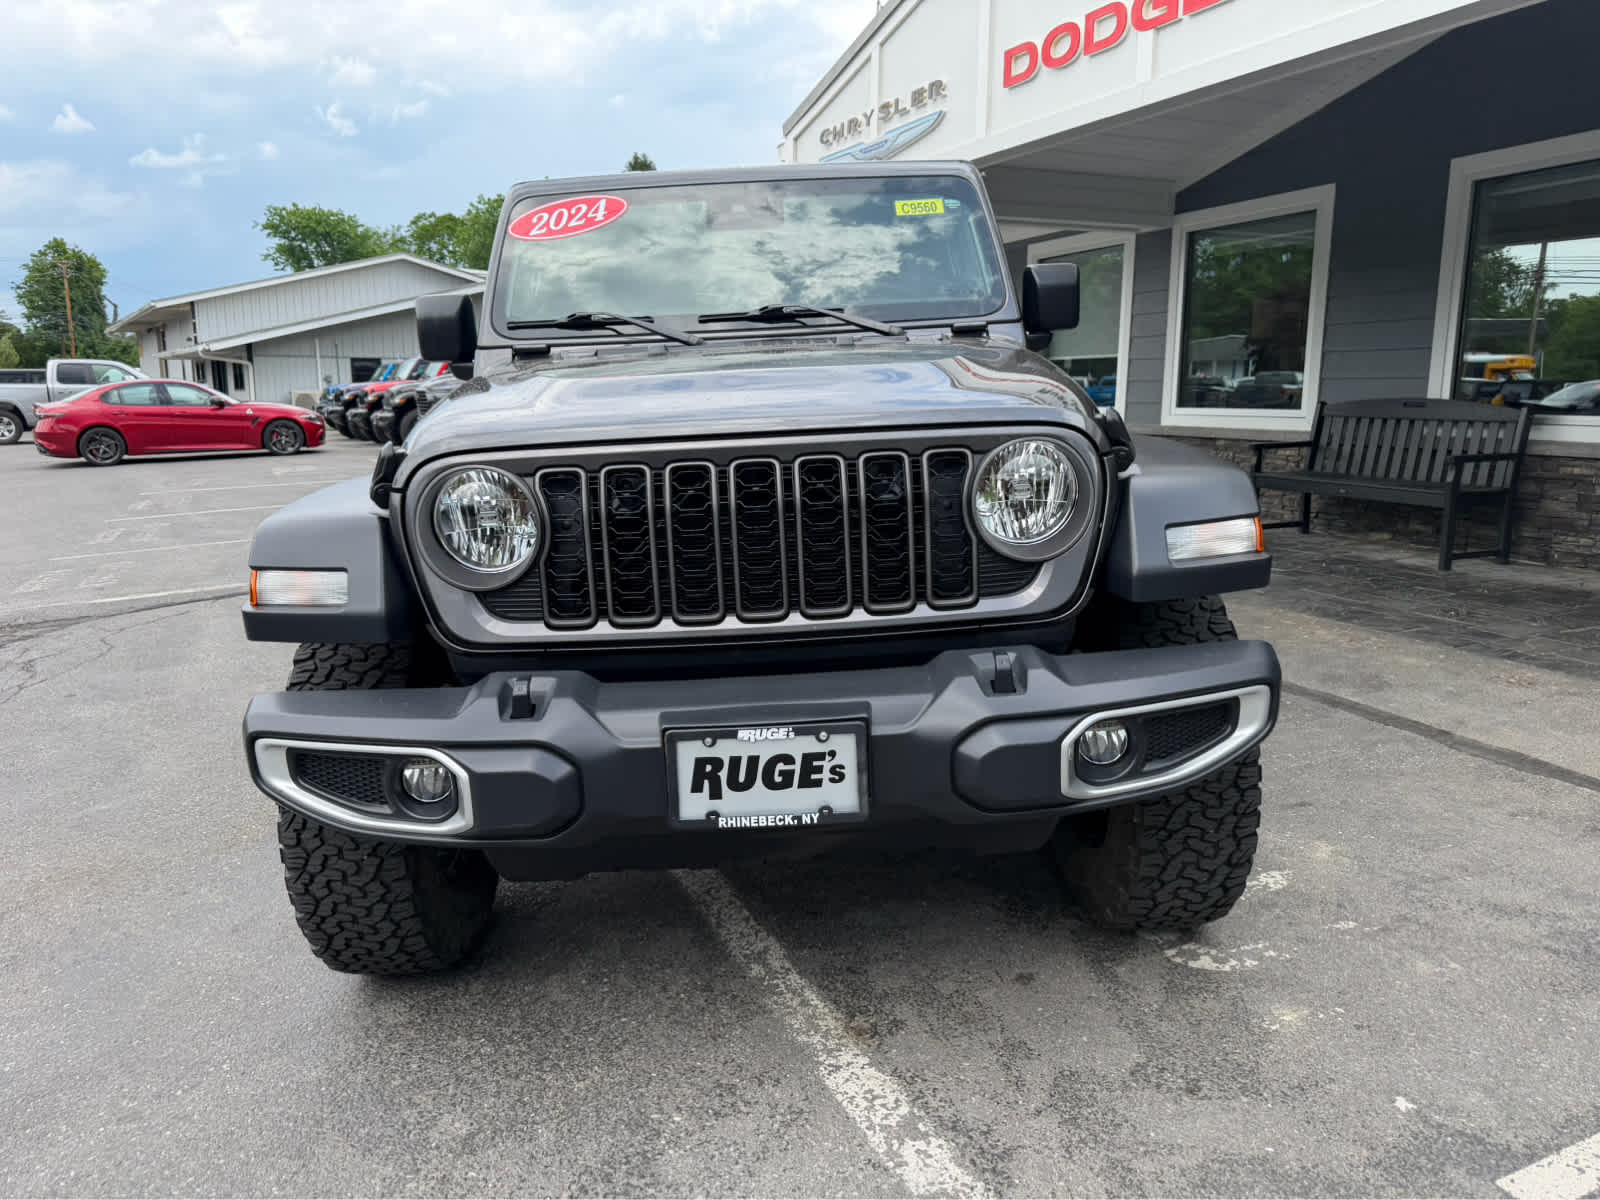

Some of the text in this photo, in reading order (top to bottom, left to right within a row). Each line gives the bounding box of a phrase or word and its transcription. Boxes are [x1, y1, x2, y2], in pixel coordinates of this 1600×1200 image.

[1003, 0, 1230, 88] DODG
[820, 79, 947, 146] CHRYSLER
[529, 198, 608, 236] 2024
[690, 749, 846, 801] RUGE's
[718, 813, 820, 828] RHINEBECK, NY
